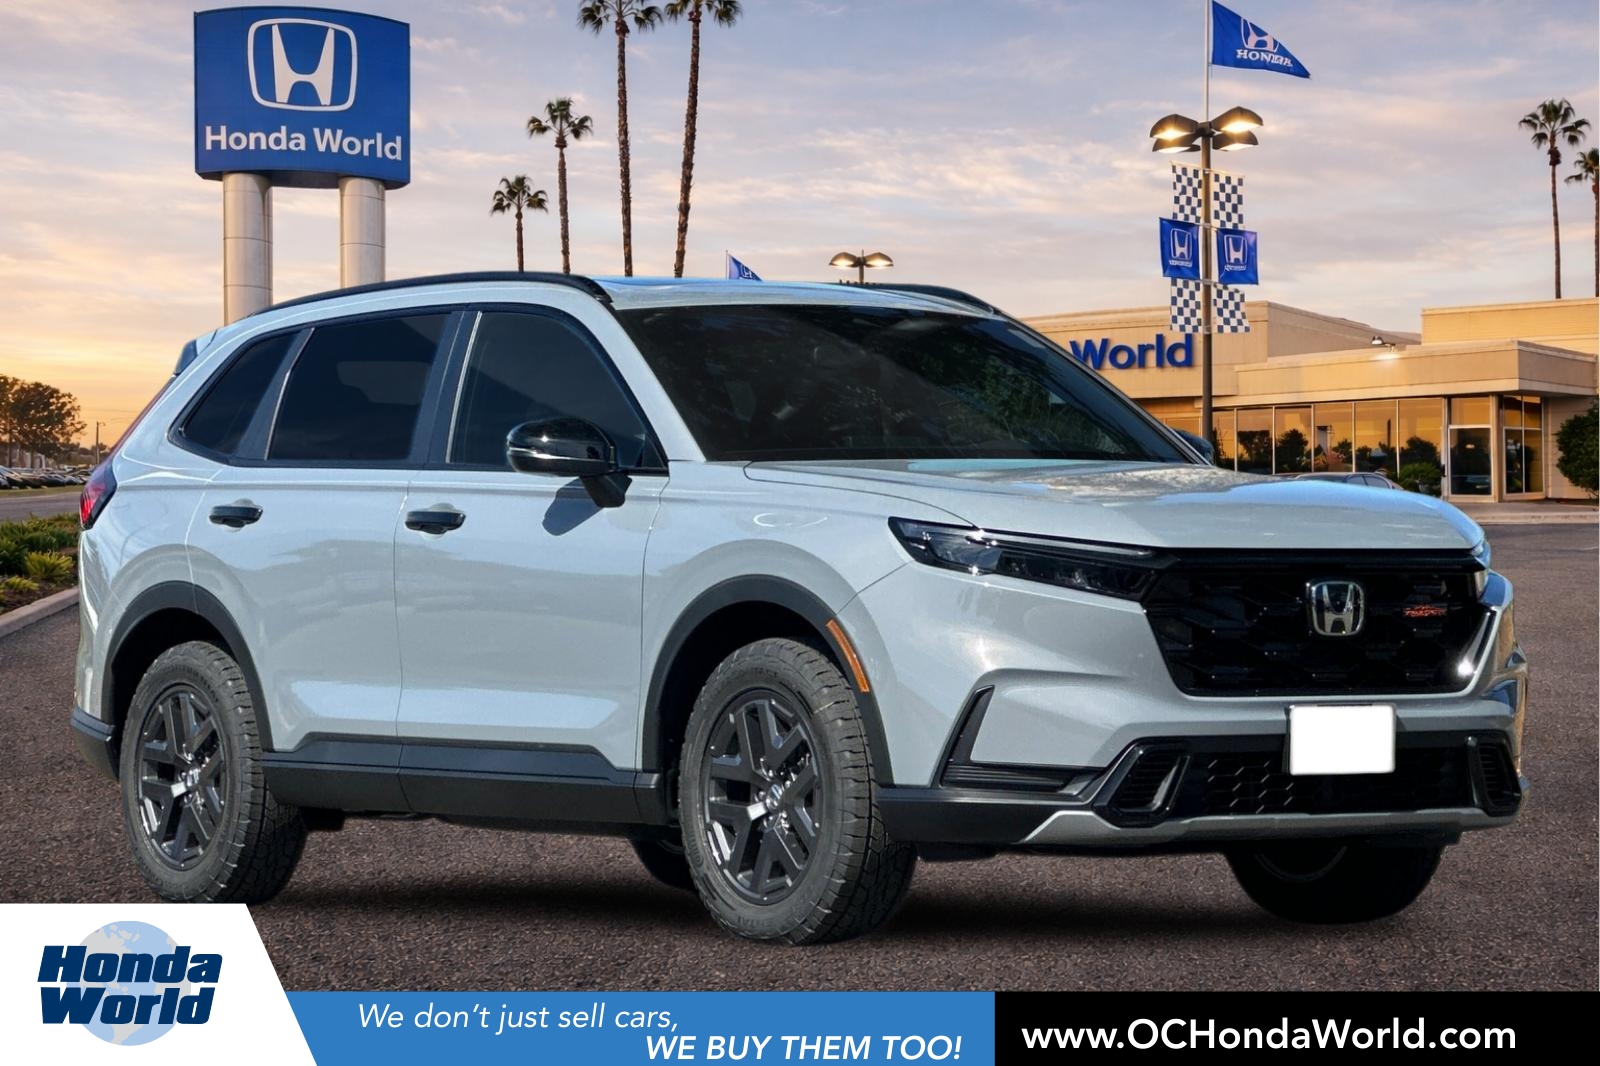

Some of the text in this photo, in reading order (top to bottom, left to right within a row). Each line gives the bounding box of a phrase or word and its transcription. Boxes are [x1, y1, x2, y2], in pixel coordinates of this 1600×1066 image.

[205, 125, 402, 161] Honda World
[1069, 333, 1194, 371] World
